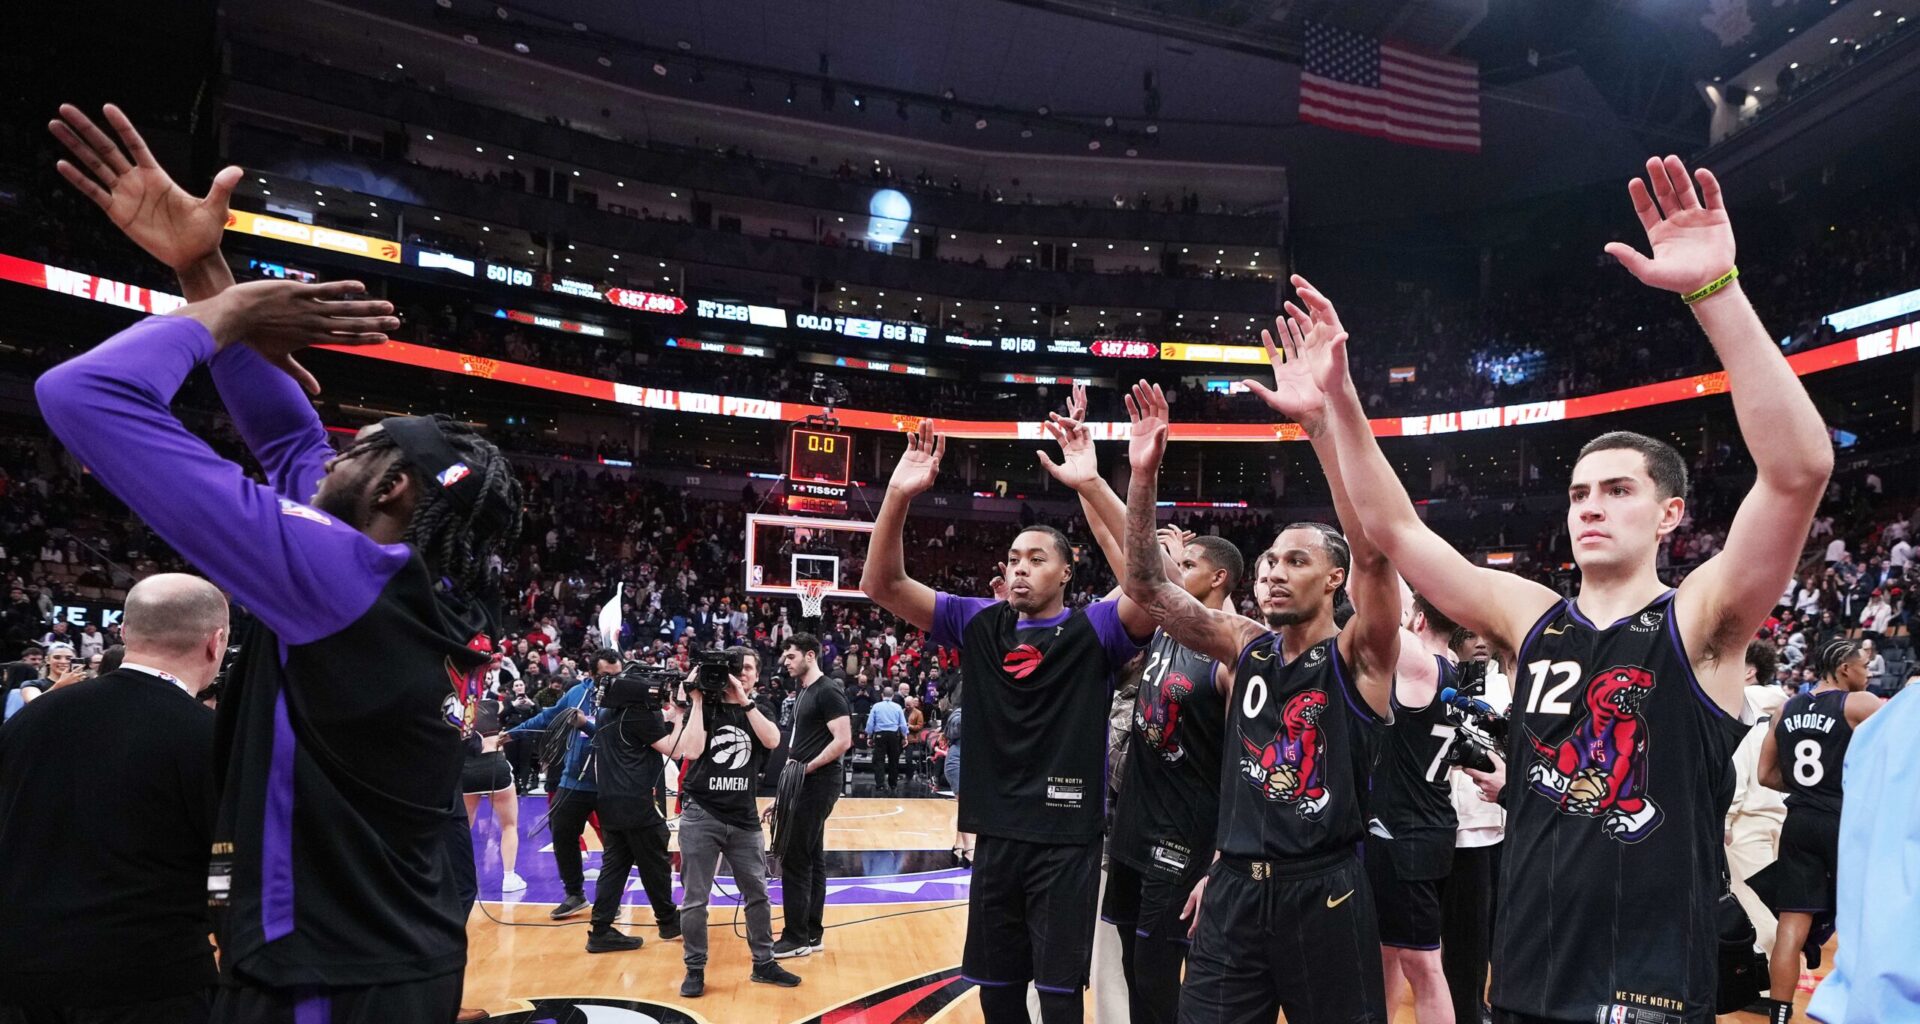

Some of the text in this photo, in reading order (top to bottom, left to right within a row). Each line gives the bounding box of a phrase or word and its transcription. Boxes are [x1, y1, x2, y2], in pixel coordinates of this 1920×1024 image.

[44, 264, 92, 299] WE
[95, 278, 146, 313] ALL
[534, 316, 561, 329] LIGHT
[796, 314, 833, 331] 00.0
[701, 342, 725, 353] LIGHT
[1000, 337, 1036, 354] 50|50
[1856, 328, 1893, 361] WE
[868, 361, 890, 371] LIGHT
[1035, 376, 1057, 385] LIGHT
[614, 383, 643, 406] WE
[645, 388, 677, 410] ALL
[678, 391, 720, 414] WIN
[1018, 422, 1041, 439] WE
[1401, 417, 1428, 436] WE
[1429, 412, 1459, 434] ALL
[1460, 407, 1501, 431] WIN
[808, 435, 834, 453] 0.0
[806, 485, 846, 496] TISSOT
[1630, 624, 1650, 633] Sun
[1142, 651, 1171, 687] 21
[1527, 659, 1582, 715] 12
[1242, 675, 1268, 719] 0
[1784, 713, 1836, 734] RHODEN
[1792, 738, 1825, 787] 8
[708, 776, 749, 791] CAMERA
[1616, 990, 1684, 1011] WE THE NORTH
